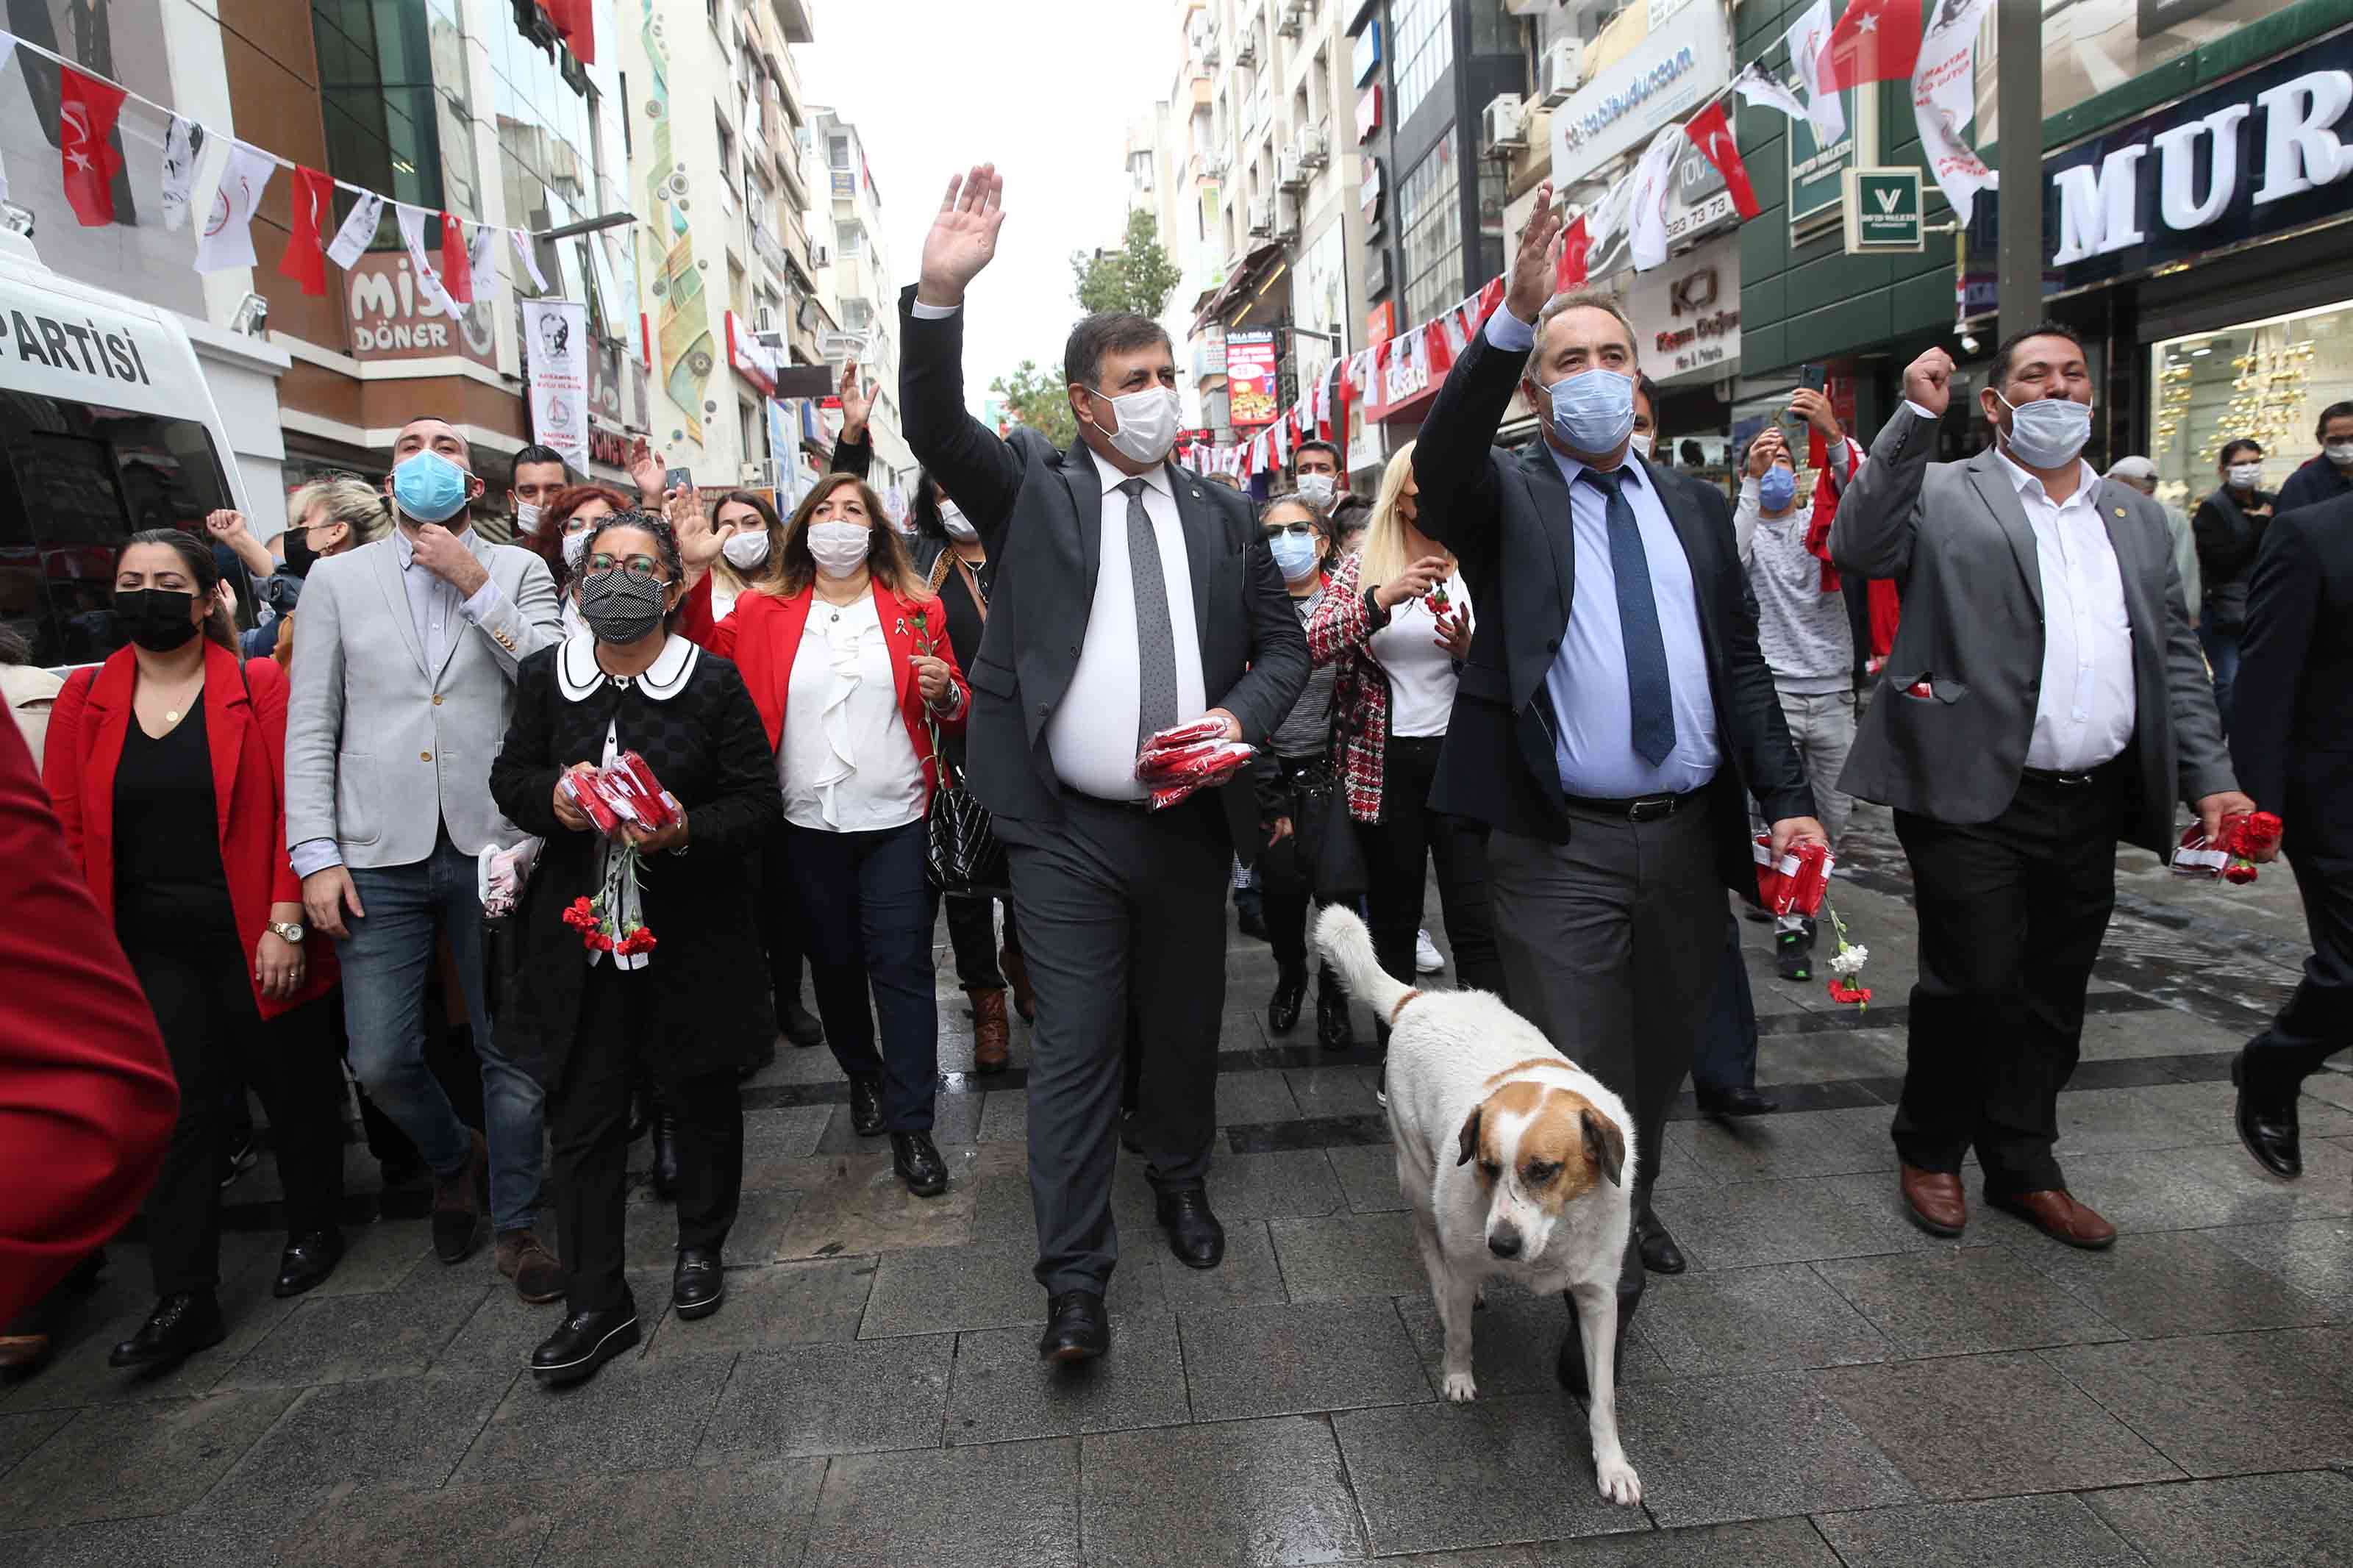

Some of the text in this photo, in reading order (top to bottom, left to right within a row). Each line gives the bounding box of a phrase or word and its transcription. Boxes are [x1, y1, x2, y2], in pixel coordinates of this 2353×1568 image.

[2052, 70, 2353, 267] MUR
[1690, 207, 1705, 226] 73
[1710, 198, 1725, 216] 73
[354, 319, 449, 351] DÖNER
